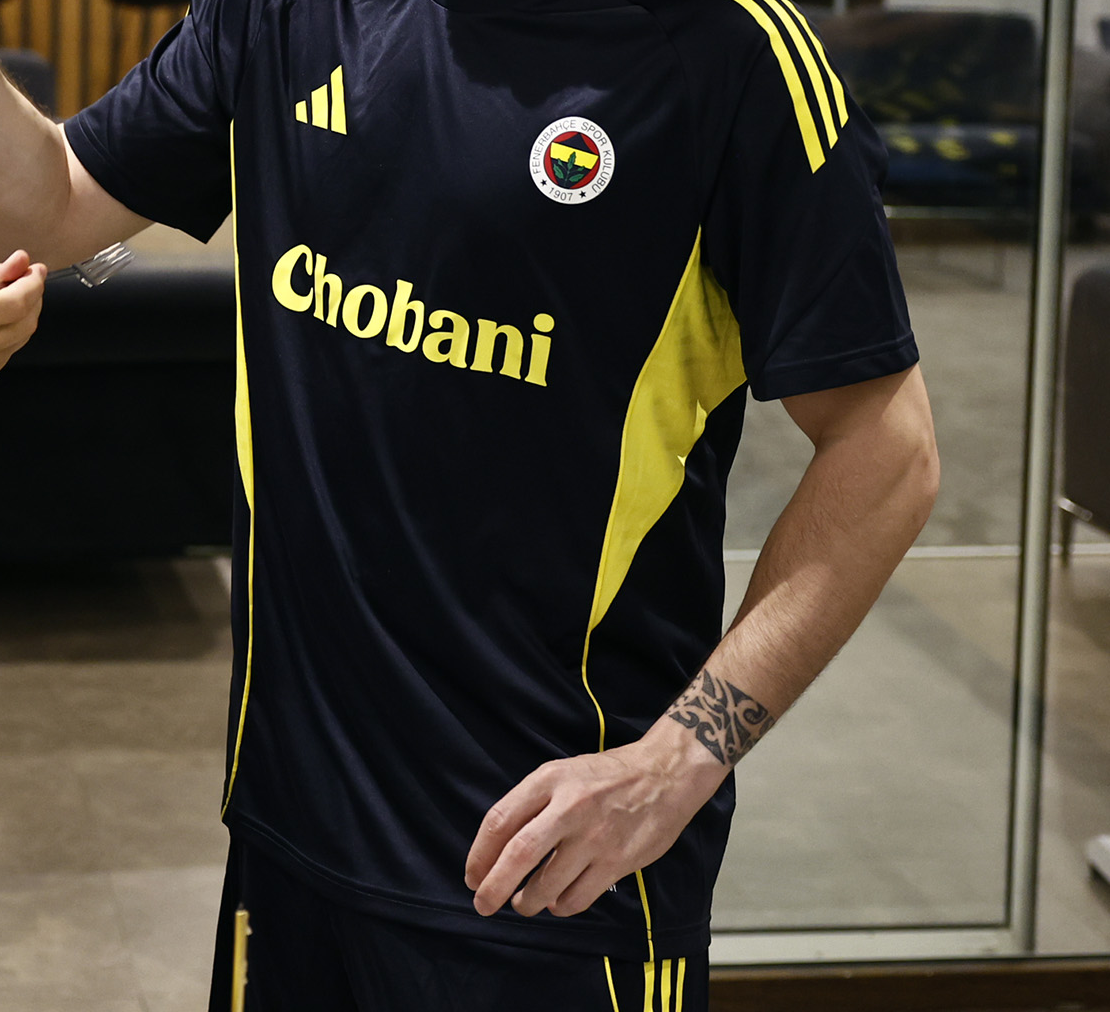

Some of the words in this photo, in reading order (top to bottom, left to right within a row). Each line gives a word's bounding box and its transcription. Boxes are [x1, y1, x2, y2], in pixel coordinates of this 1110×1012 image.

[532, 119, 576, 175] FENERBAHÇE
[580, 121, 608, 147] SPOR
[548, 187, 574, 202] 1907
[271, 244, 555, 387] Chobani
